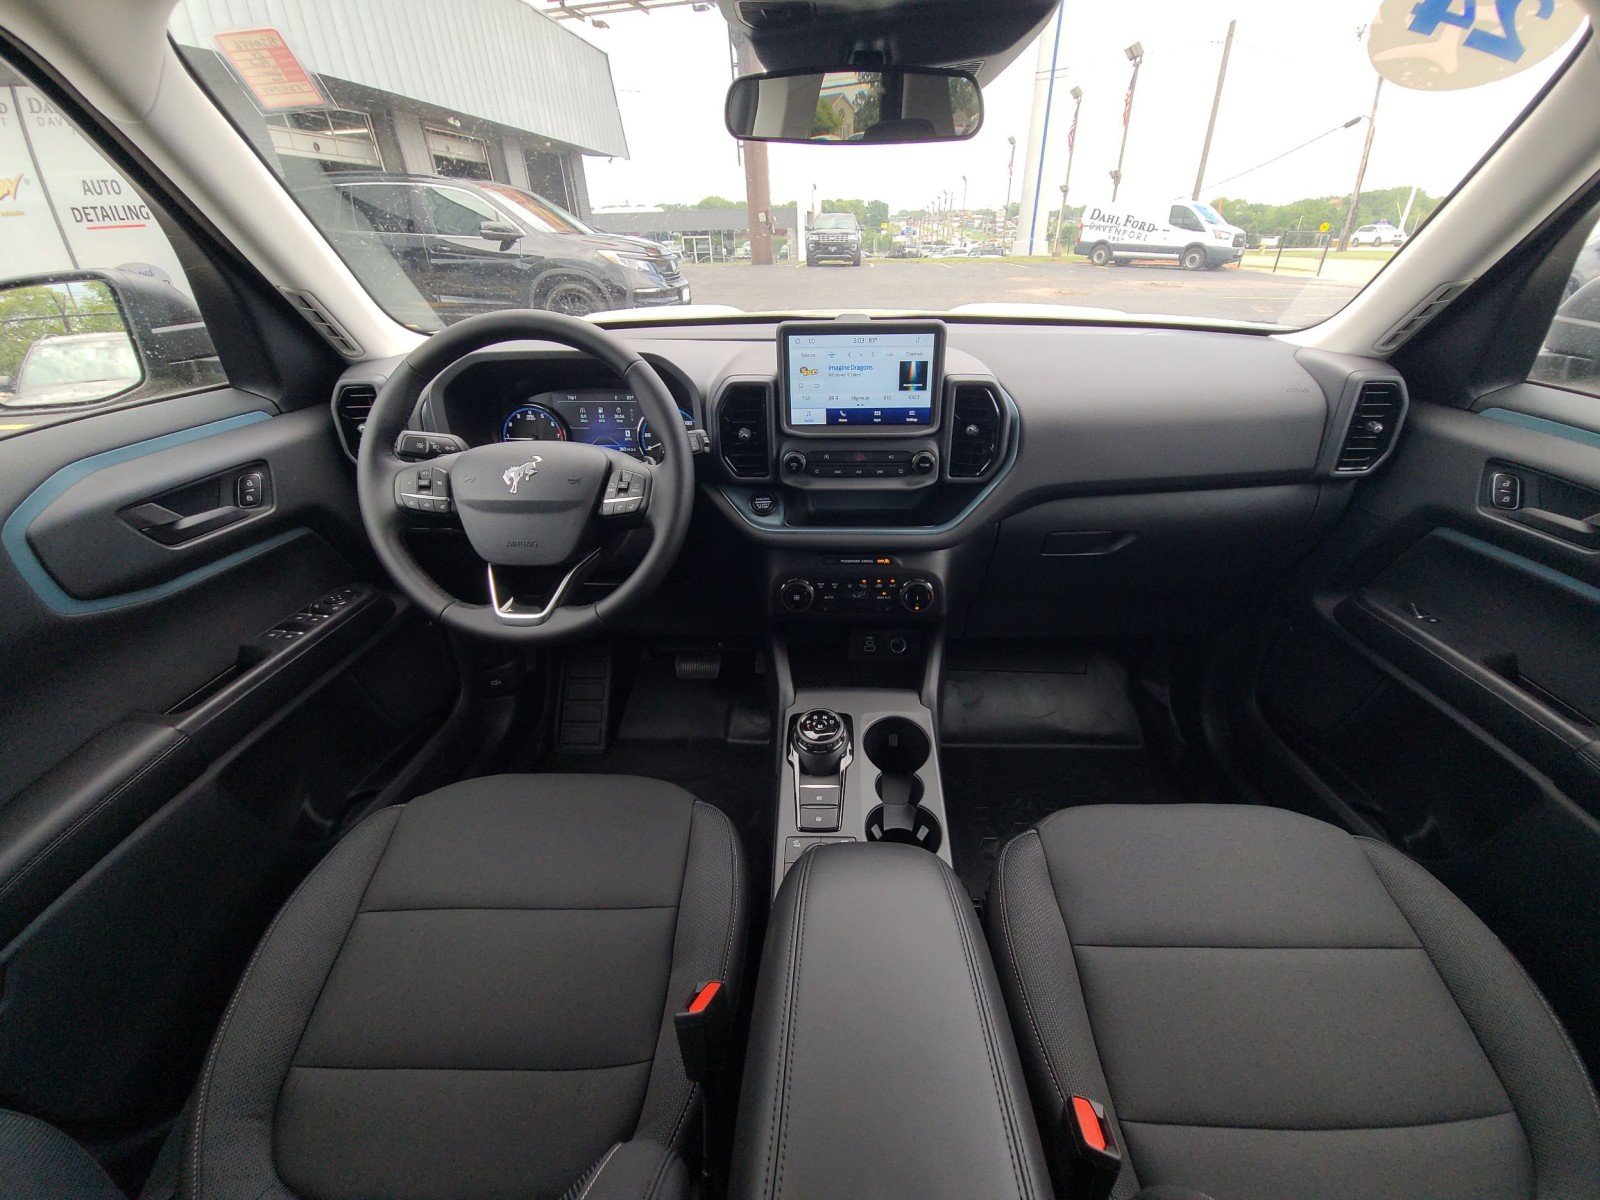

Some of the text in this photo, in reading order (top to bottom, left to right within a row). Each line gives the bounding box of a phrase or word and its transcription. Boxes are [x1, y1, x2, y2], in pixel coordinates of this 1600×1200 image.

[81, 179, 122, 196] AUTO
[70, 204, 151, 223] DETAILING
[1089, 208, 1156, 233] DAHL FORD
[1088, 222, 1148, 241] DAVENPORT
[828, 364, 850, 372] Imagine
[850, 364, 873, 372] Dragons
